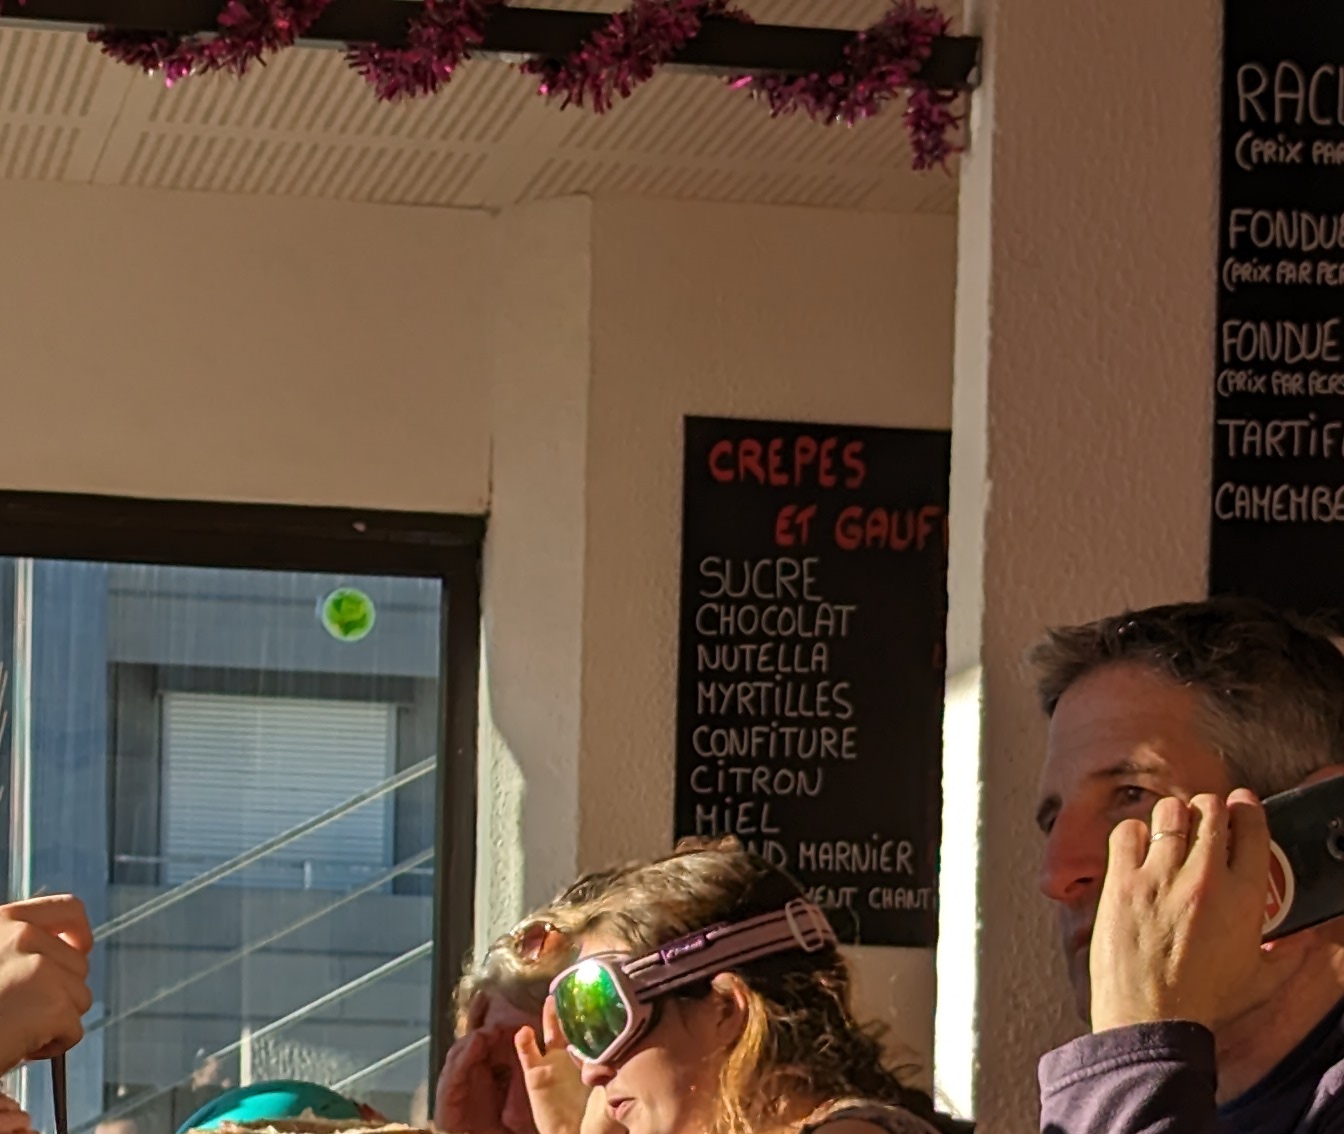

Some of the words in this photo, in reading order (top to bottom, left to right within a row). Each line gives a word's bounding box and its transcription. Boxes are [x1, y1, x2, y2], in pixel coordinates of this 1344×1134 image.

[1276, 262, 1313, 285] PAR
[1221, 317, 1341, 364] FONDUE
[709, 435, 867, 488] CREPES
[775, 504, 817, 547] ET
[834, 504, 948, 550] GAUF
[699, 556, 822, 601] SUCRE
[696, 602, 856, 637] CHOCOLAT
[697, 642, 829, 673] NUTELLA
[696, 673, 854, 720] MYRTILLES
[692, 721, 858, 759] CONFITURE
[690, 759, 823, 796] CITRON
[868, 886, 936, 910] CHANT
